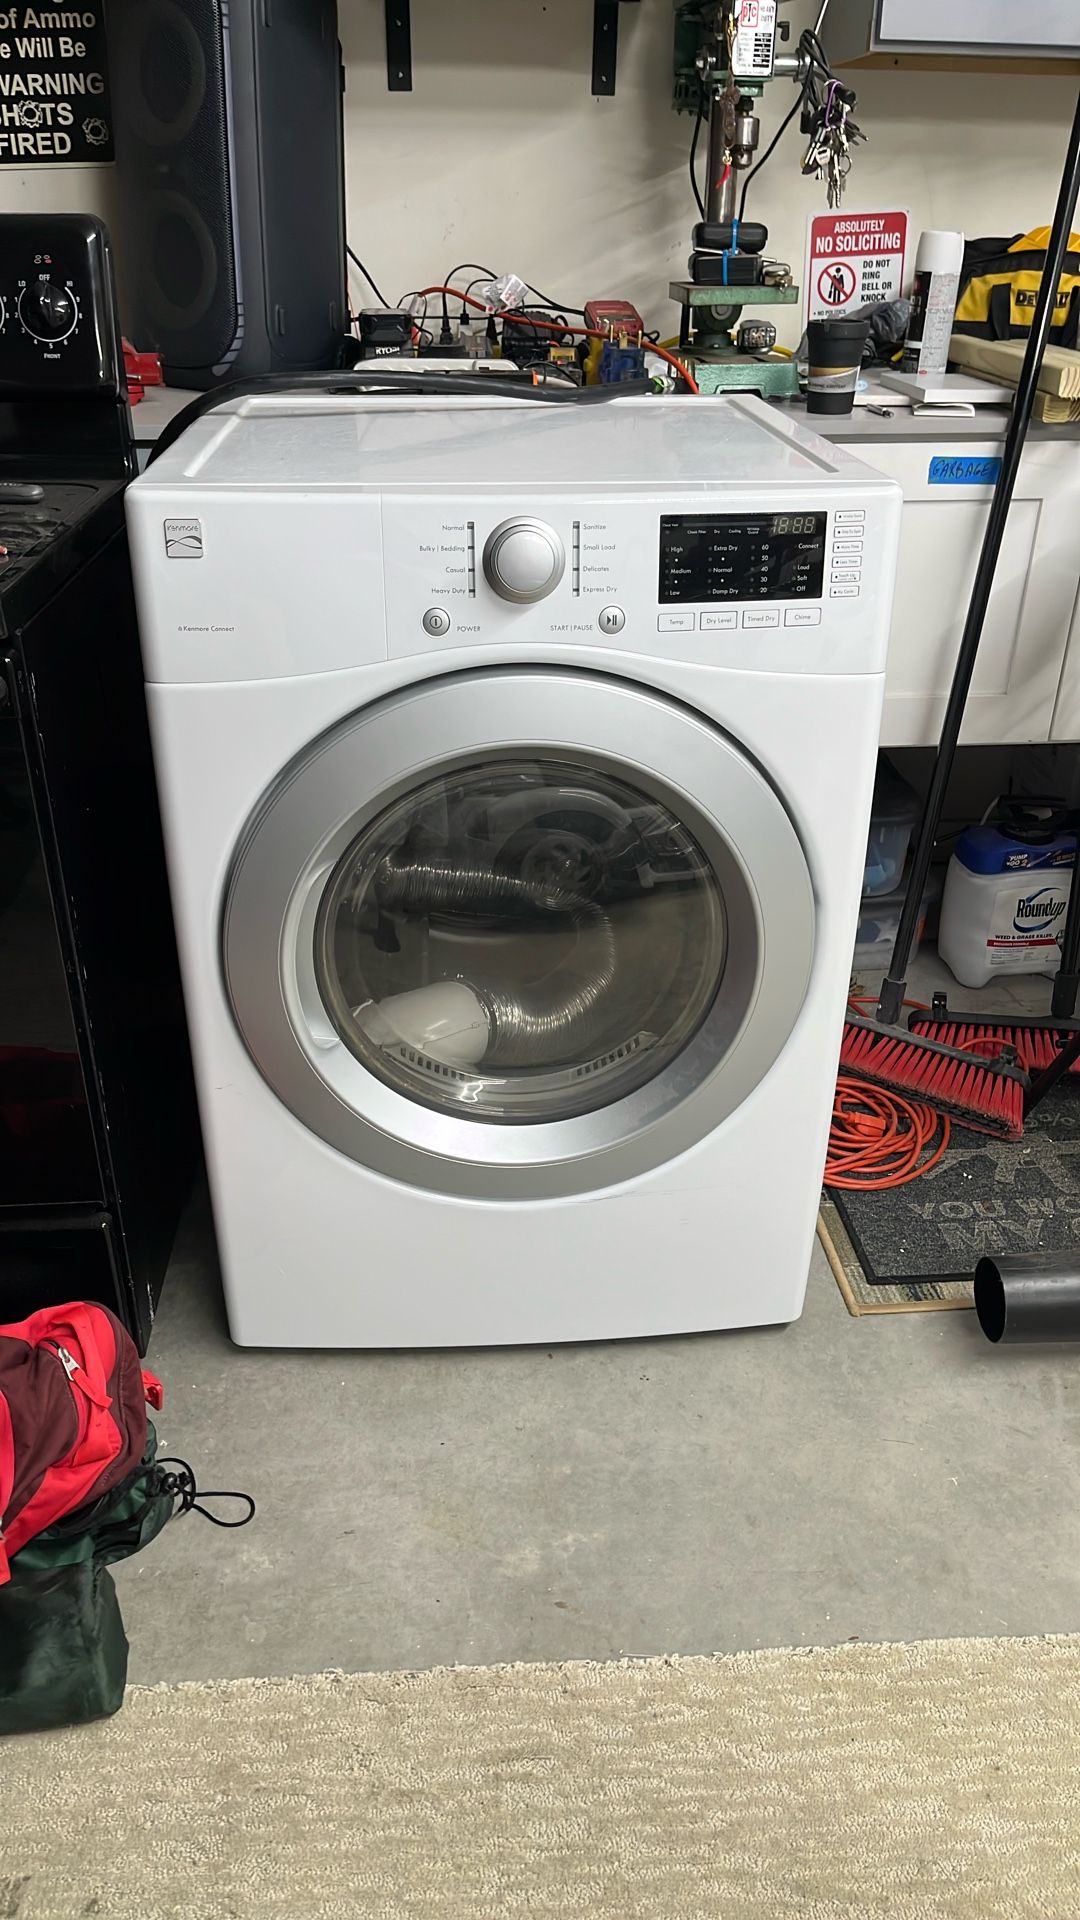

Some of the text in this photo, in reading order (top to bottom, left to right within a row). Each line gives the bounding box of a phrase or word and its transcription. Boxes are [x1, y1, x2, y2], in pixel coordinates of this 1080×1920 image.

[0, 7, 97, 29] of Ammo
[14, 36, 54, 59] Will
[58, 36, 87, 58] Be
[0, 132, 72, 156] FIRED
[834, 219, 885, 234] ABSOLUTELY
[816, 232, 901, 253] NO SOLICITING
[862, 259, 891, 269] DO NOT
[862, 271, 881, 280] RING
[861, 281, 892, 291] BELL OR
[860, 292, 887, 303] KNOCK
[932, 459, 991, 479] GARBAGE
[440, 545, 466, 553] Bedding
[670, 546, 684, 554] High
[728, 544, 738, 552] Dry
[606, 585, 617, 593] Dry
[550, 624, 569, 632] START
[1016, 897, 1067, 921] Roundup
[906, 1199, 1006, 1220] YOU
[937, 1218, 1045, 1251] MY
